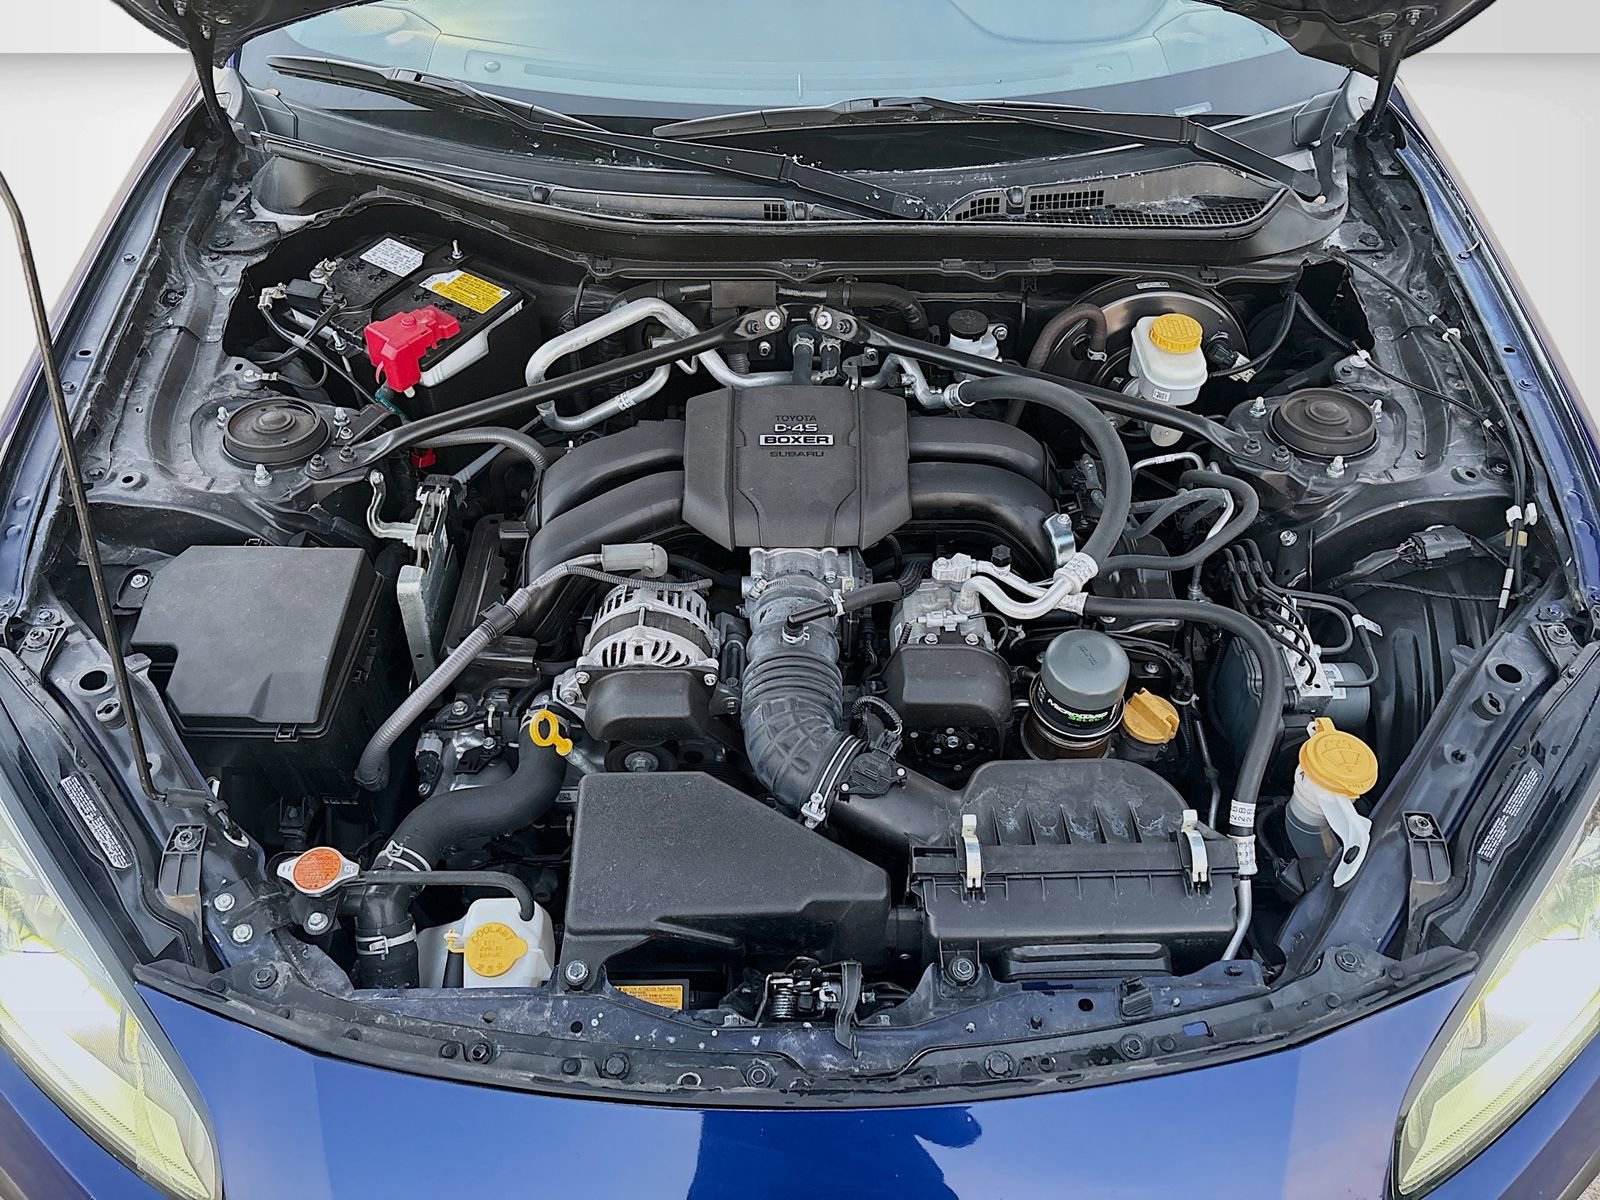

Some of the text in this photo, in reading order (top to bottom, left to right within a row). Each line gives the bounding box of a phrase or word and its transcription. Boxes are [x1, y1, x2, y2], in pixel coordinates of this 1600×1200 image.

[774, 423, 818, 432] D-4S
[764, 436, 830, 444] BOXER
[471, 925, 514, 944] COOLANT
